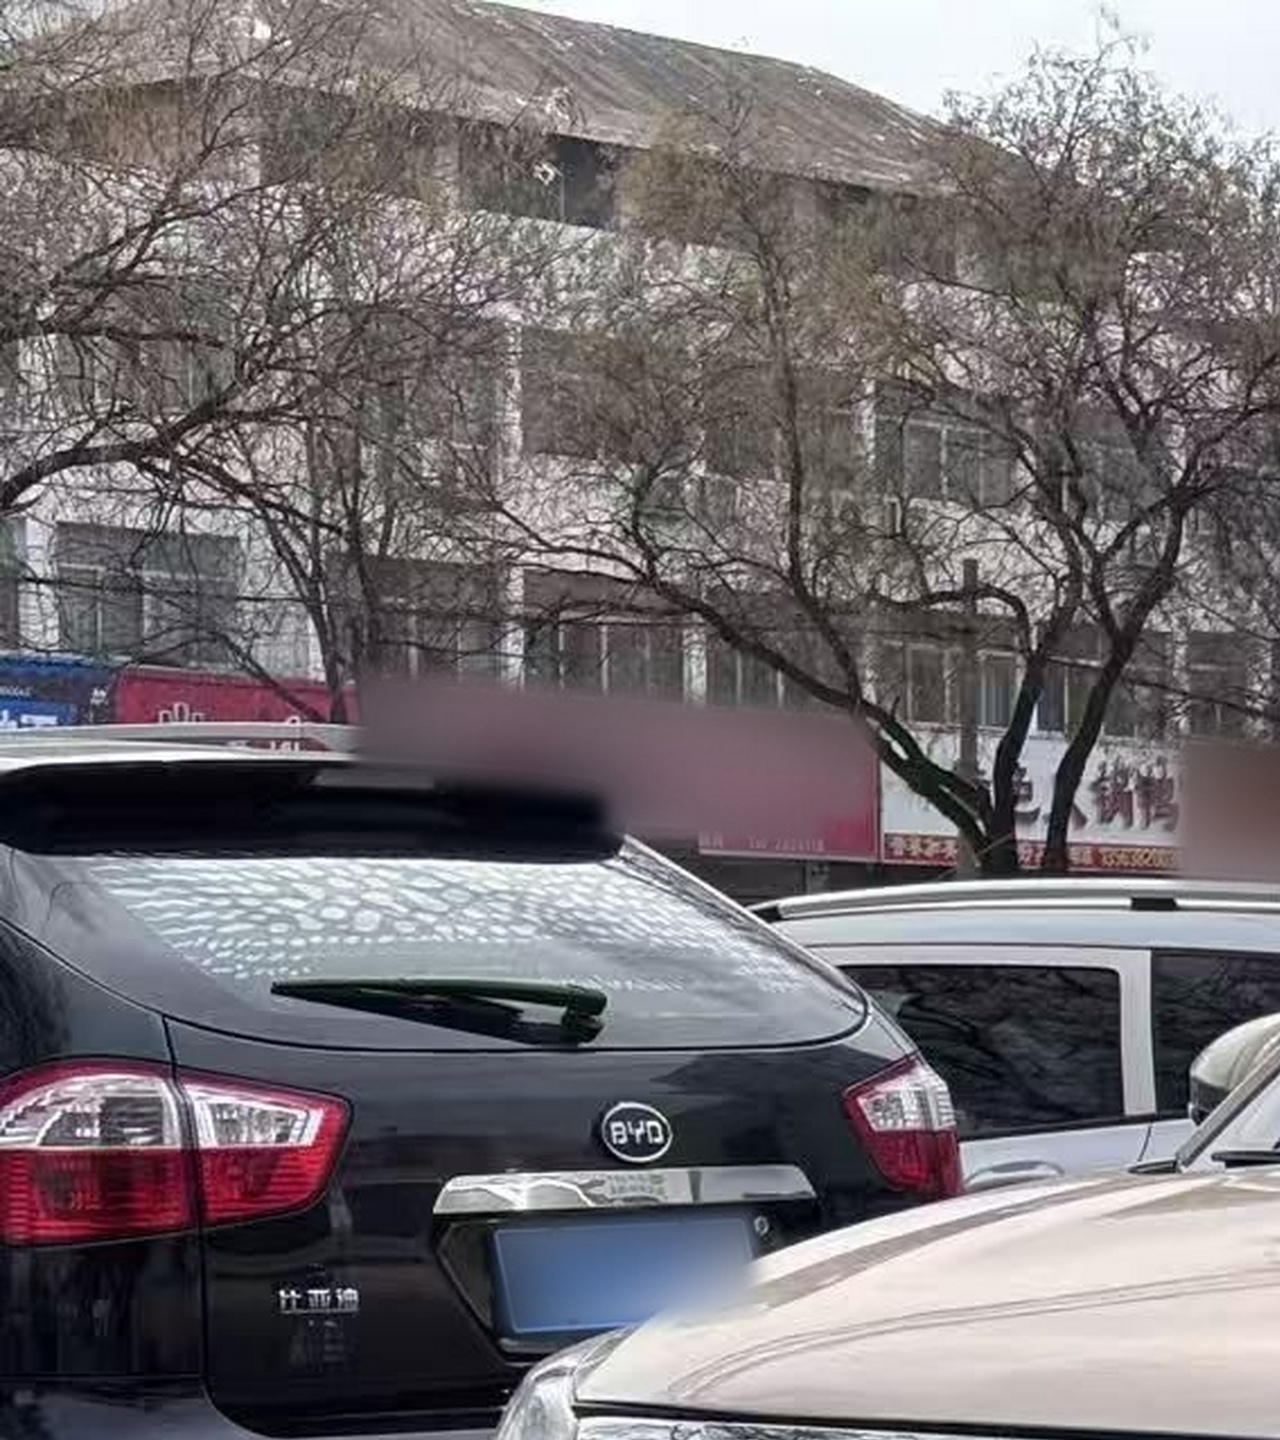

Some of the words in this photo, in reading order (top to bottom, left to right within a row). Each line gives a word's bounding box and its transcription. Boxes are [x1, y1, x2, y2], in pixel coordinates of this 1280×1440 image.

[609, 1120, 665, 1145] BYD
[279, 1286, 360, 1314] 比亚迪
